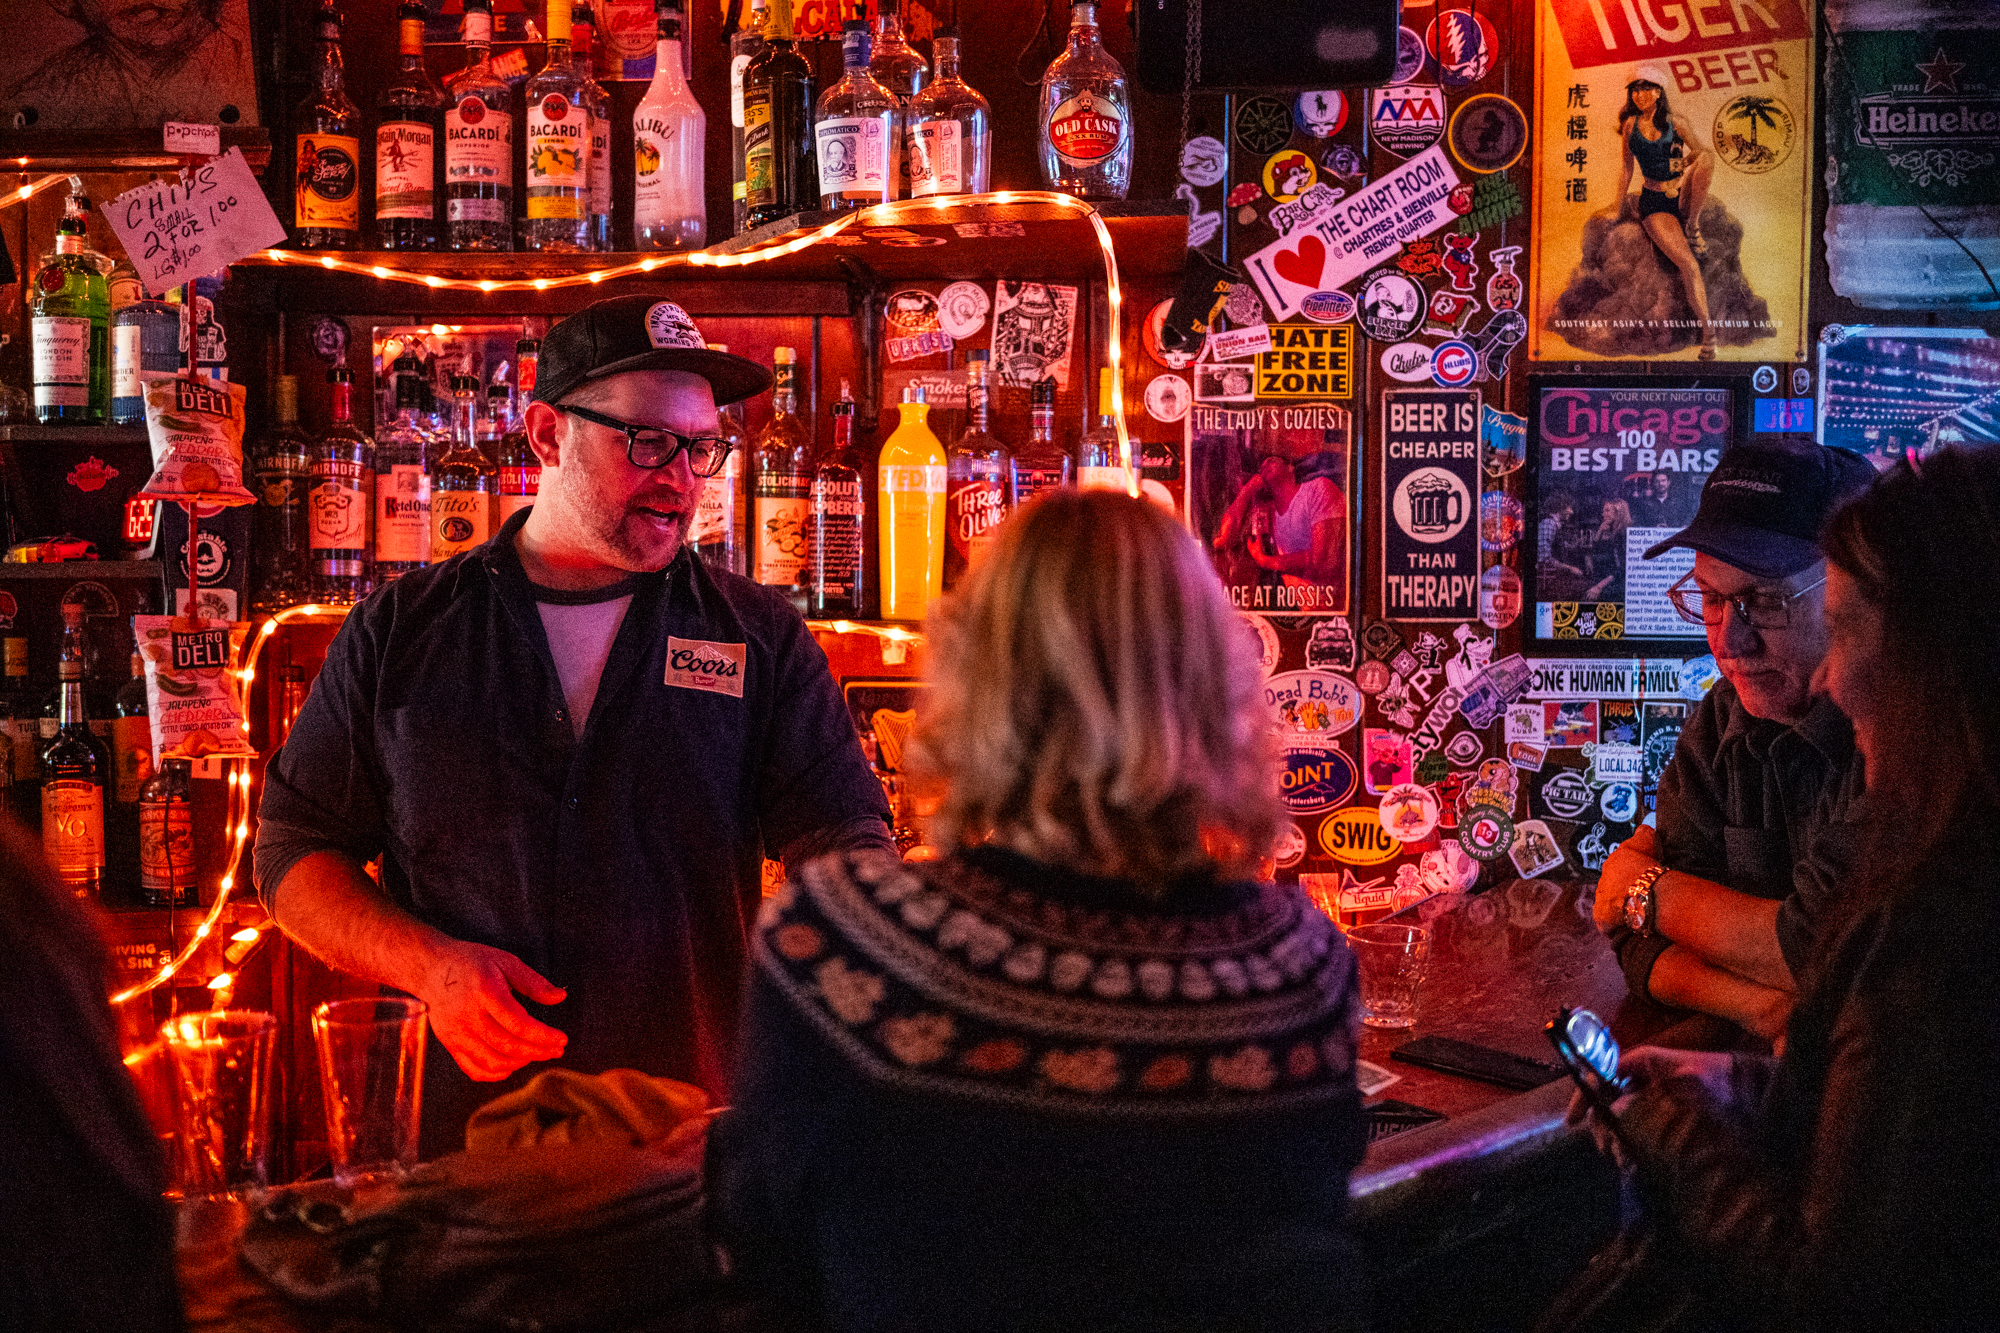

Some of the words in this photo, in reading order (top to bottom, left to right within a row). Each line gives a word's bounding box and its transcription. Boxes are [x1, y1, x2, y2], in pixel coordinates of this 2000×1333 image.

[1669, 49, 1788, 93] BEER
[636, 118, 675, 140] ALIBU
[1055, 119, 1080, 137] OLD
[1084, 118, 1118, 134] CASK
[1868, 106, 2000, 133] Heineke
[400, 128, 432, 146] Morgan
[449, 126, 500, 141] BACARDÍ
[530, 123, 581, 138] BACARDÍ
[1401, 134, 1435, 142] MADISON
[126, 166, 218, 231] CHIPS
[1316, 213, 1351, 245] THE
[1347, 183, 1397, 227] CHART
[1394, 156, 1446, 199] ROOM
[154, 209, 196, 233] SMALL
[1342, 216, 1395, 254] CHARTRES
[1393, 211, 1404, 224] &
[1401, 182, 1450, 219] BIENVILLE
[1362, 230, 1398, 259] FRENCH
[1396, 208, 1438, 240] QUARTER
[143, 231, 168, 259] 2
[1303, 299, 1352, 313] Pipefitters
[1554, 319, 1609, 329] SOUTHEAST
[1613, 320, 1645, 329] ASIA'S
[1663, 320, 1703, 329] SELLING
[1707, 320, 1750, 329] PREMIUM
[1753, 320, 1783, 329] LAGER
[36, 332, 81, 346] Tanqueray
[655, 336, 691, 347] WORKING
[889, 331, 951, 357] UPRISE
[1215, 338, 1246, 350] UNION
[1247, 333, 1267, 343] BAR
[1269, 328, 1348, 348] HATE
[1262, 351, 1348, 371] FREE
[1262, 373, 1348, 393] ZONE
[180, 392, 229, 416] DELI
[1610, 392, 1638, 402] YOUR
[1641, 392, 1667, 402] NEXT
[1670, 393, 1702, 402] NIGHT
[1705, 393, 1726, 402] OUT
[1195, 409, 1222, 430] THE
[1227, 409, 1279, 430] LADY'S
[1284, 408, 1344, 430] COZIEST
[1390, 403, 1447, 432] BEER
[1454, 403, 1474, 432] IS
[1540, 390, 1730, 445] Chicago
[1763, 409, 1805, 429] JOY
[1617, 430, 1656, 448] 100
[1389, 442, 1475, 459] CHEAPER
[1551, 448, 1629, 471] BEST
[1636, 449, 1720, 473] BARS
[309, 461, 362, 476] SMIRNOFF
[809, 481, 859, 496] ABSOLUT
[385, 497, 413, 518] Ketel
[414, 499, 432, 512] One
[436, 497, 480, 513] Tito's
[699, 501, 723, 510] NILLA
[950, 483, 1002, 516] THREE
[958, 503, 1007, 542] OLIVES
[179, 532, 228, 554] Cstable
[1407, 553, 1456, 568] THAN
[1222, 586, 1249, 608] ACE
[1254, 586, 1273, 608] AT
[1277, 585, 1334, 607] ROSSI'S
[1387, 575, 1476, 608] THERAPY
[177, 631, 222, 647] METRO
[178, 646, 225, 667] DELI
[671, 649, 738, 676] Coors
[1532, 670, 1564, 691] ONE
[1569, 671, 1625, 692] HUMAN
[1630, 671, 1680, 692] FAMILY
[1265, 679, 1301, 706] Dead
[1308, 680, 1348, 705] Bob's
[165, 698, 211, 711] JALAPEÑO
[1603, 701, 1634, 717] THRUS
[1330, 708, 1354, 723] TOO
[1517, 750, 1537, 763] TOOL
[1280, 761, 1334, 789] OINT
[1290, 796, 1326, 805] petersburg
[1542, 784, 1562, 798] PIG
[56, 813, 87, 838] VO
[1482, 826, 1492, 839] 19
[1332, 821, 1391, 851] SWIG
[1461, 831, 1493, 858] COUNTRY
[1496, 831, 1511, 853] CLUB
[1354, 892, 1385, 905] liquid
